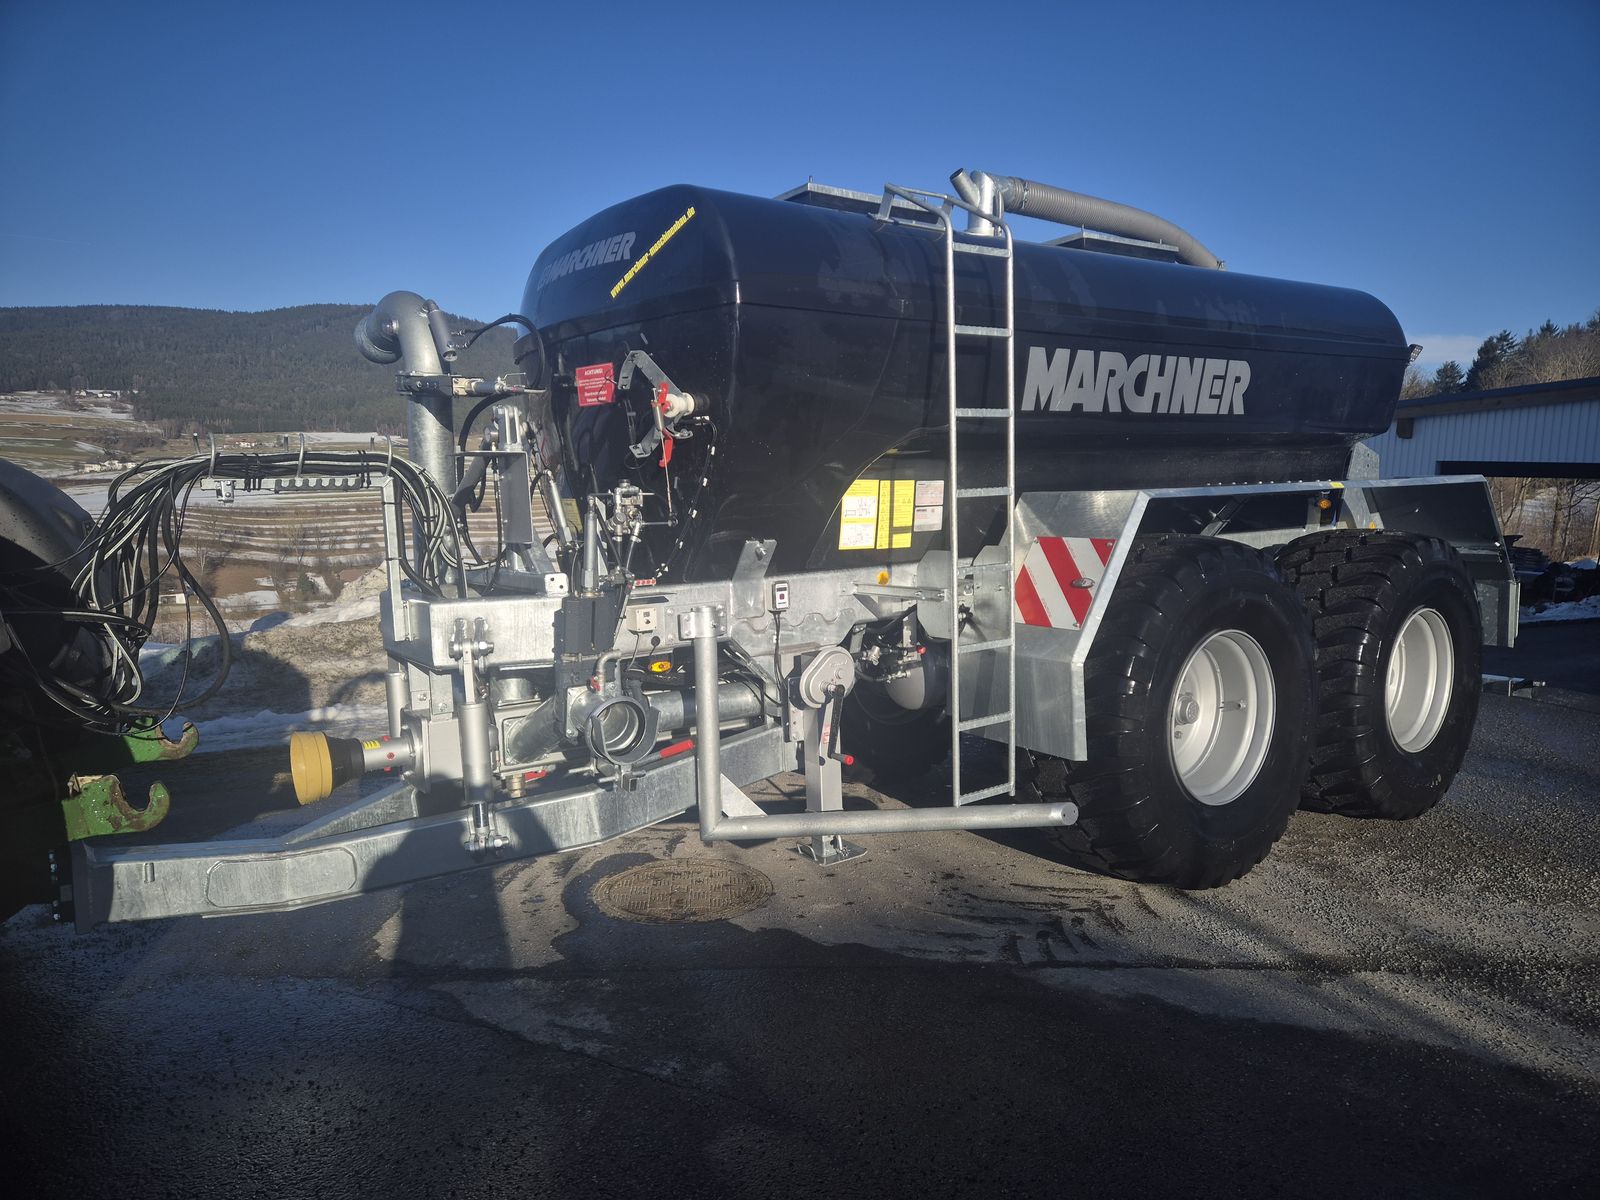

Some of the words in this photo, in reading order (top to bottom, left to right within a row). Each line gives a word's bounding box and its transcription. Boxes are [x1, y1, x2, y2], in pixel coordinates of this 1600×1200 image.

[550, 231, 637, 282] MARCHNER
[610, 206, 696, 298] www.marchner-maschinenbau.de
[1021, 346, 1251, 415] MARCHNER
